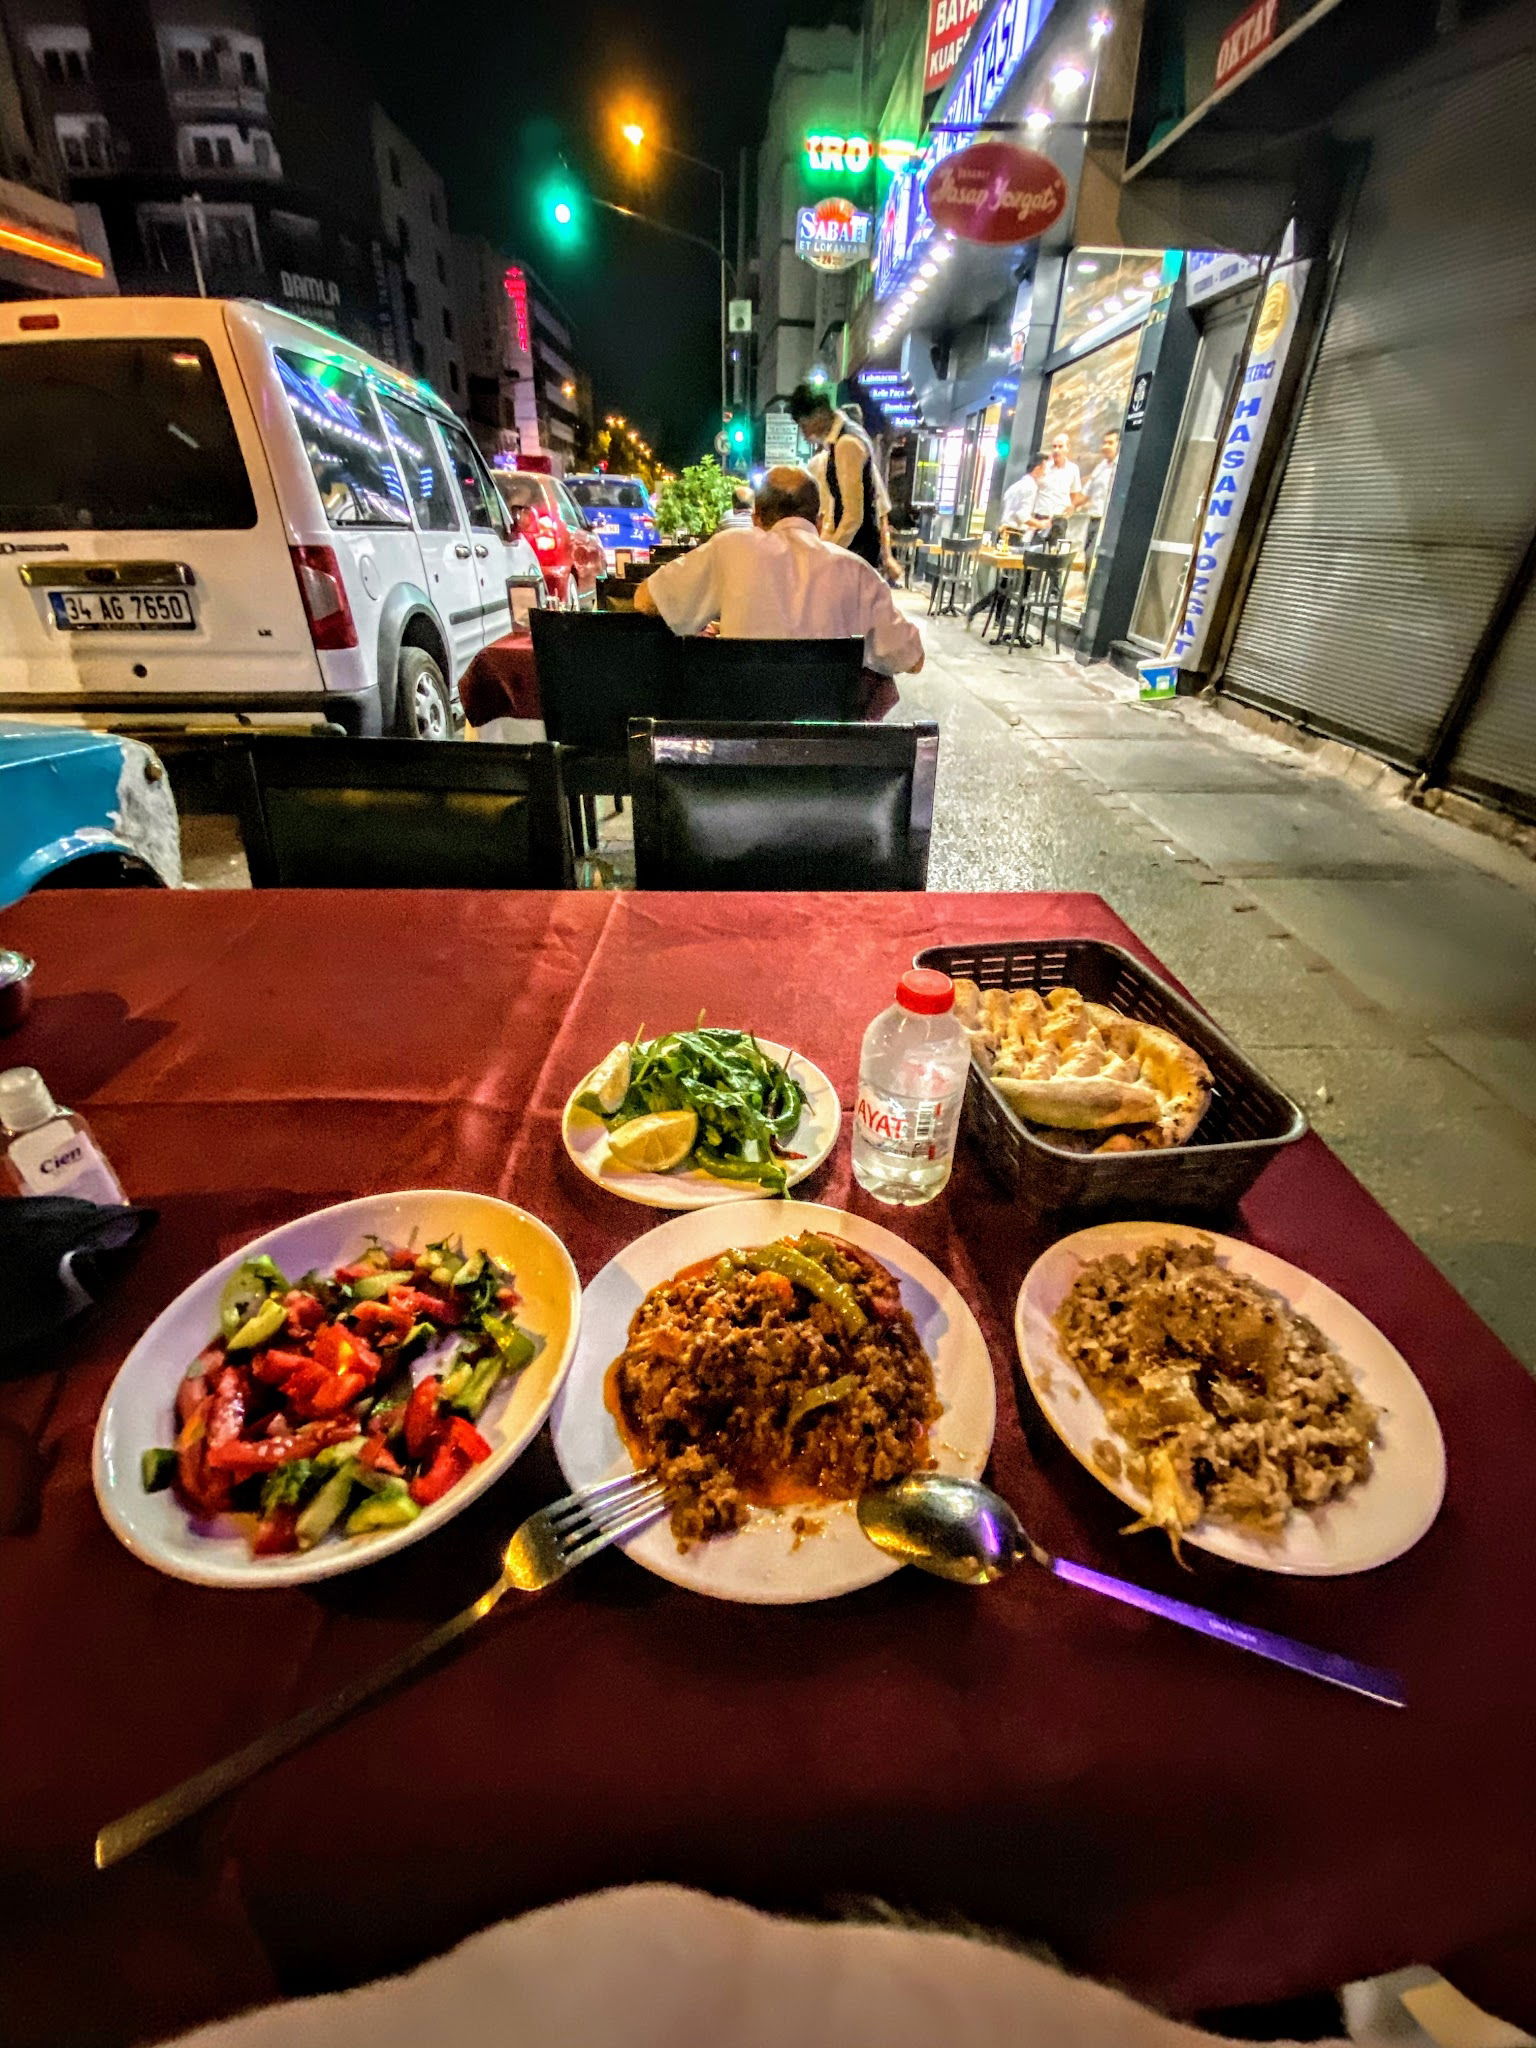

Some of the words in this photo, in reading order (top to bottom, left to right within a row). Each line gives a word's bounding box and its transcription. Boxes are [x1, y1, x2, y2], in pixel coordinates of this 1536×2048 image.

[800, 211, 869, 243] SABAH
[1206, 397, 1262, 518] HASAN
[65, 597, 92, 620] 34
[98, 595, 125, 621] AG
[129, 595, 184, 620] 7650
[40, 1147, 82, 1175] Cien
